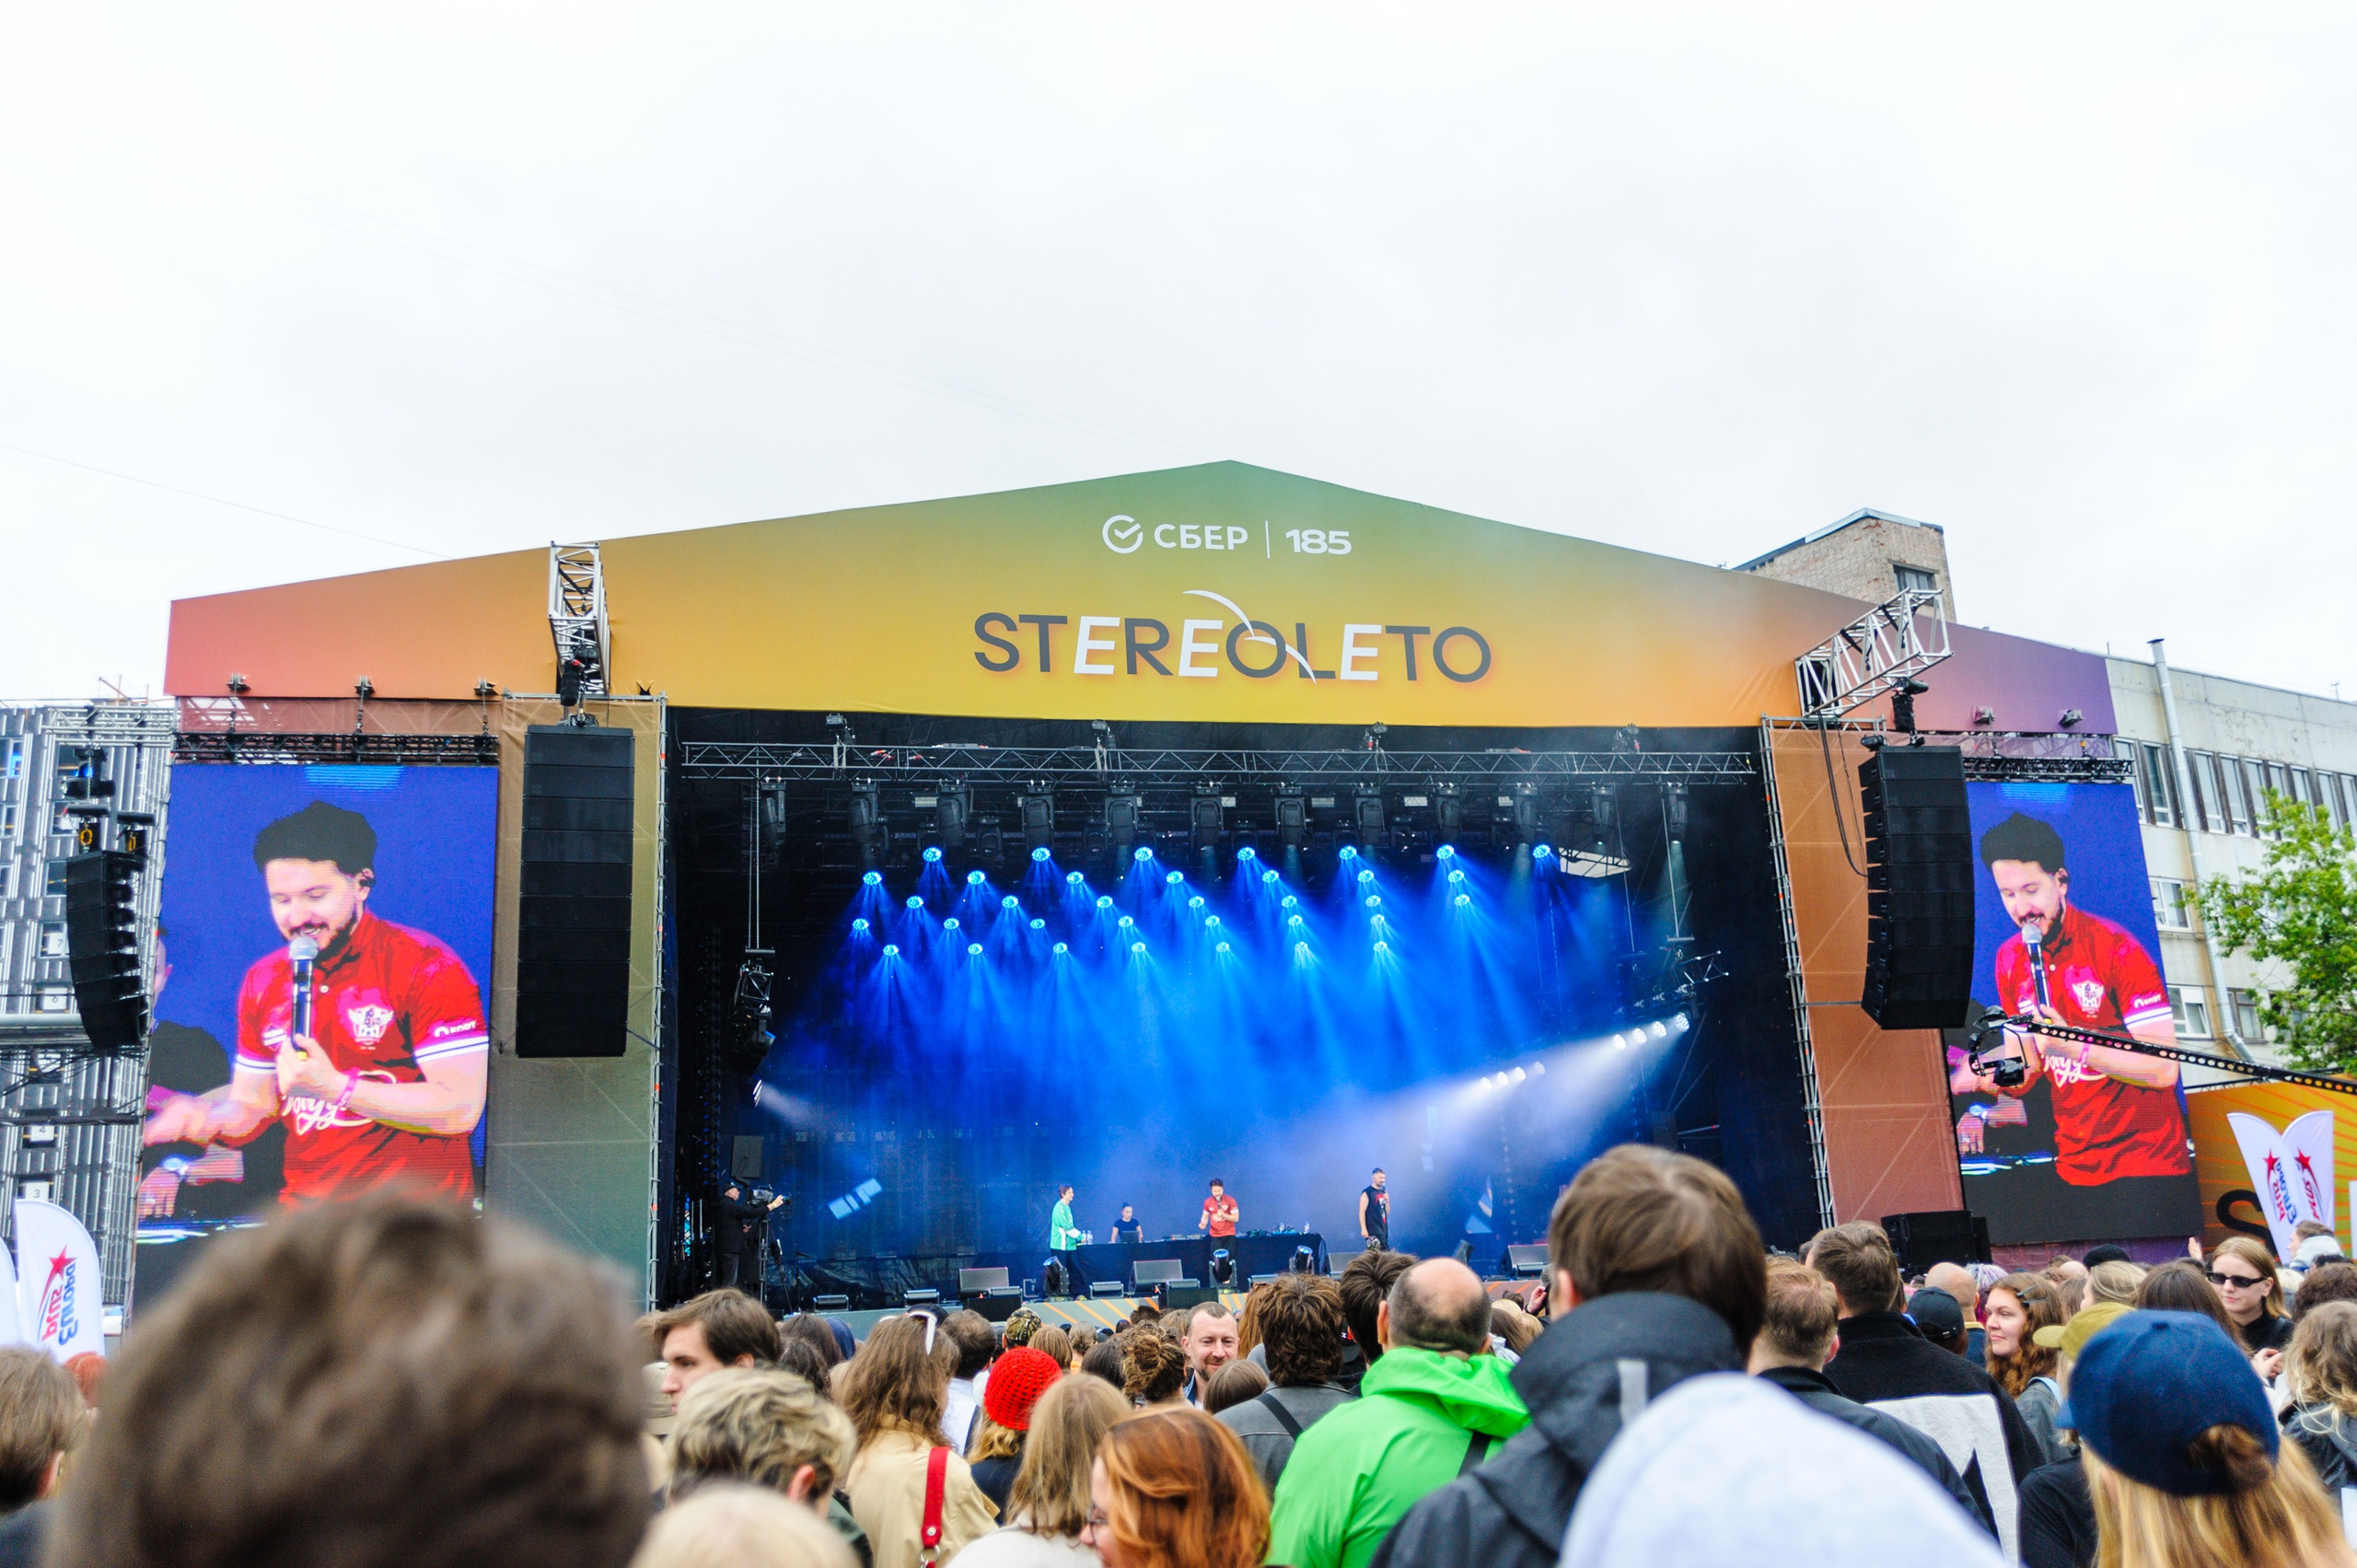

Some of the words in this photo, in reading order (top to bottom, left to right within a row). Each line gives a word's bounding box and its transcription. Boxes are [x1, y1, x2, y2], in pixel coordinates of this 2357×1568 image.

[1154, 523, 1248, 551] СБЕР
[1285, 528, 1352, 555] 185
[973, 611, 1492, 683] STEREOLETO
